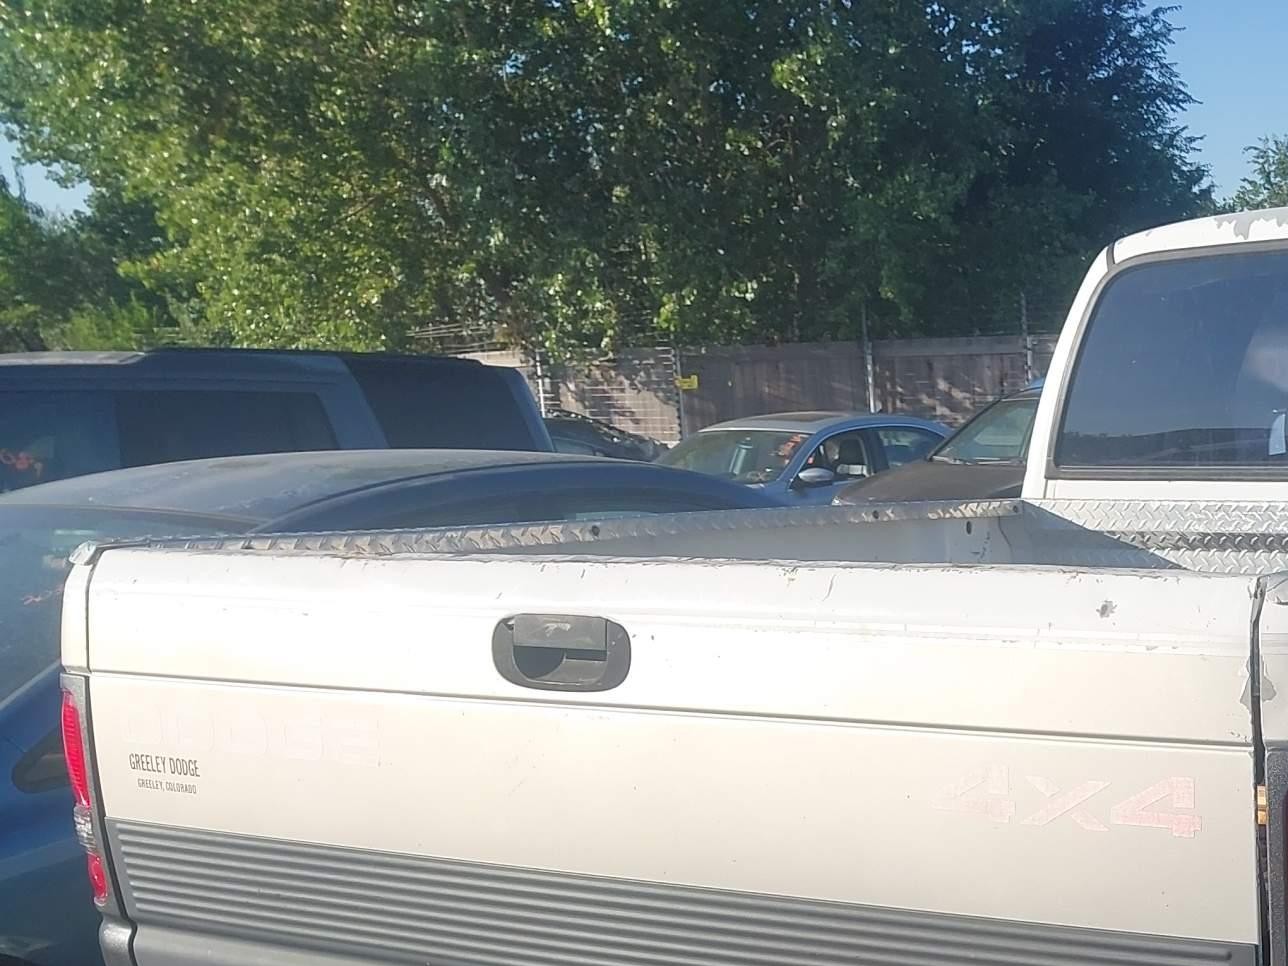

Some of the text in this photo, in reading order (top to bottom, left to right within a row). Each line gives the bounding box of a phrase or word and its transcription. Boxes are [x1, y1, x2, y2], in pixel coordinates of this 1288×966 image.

[129, 753, 200, 777] GREELEY DODGE
[137, 778, 197, 795] GREELEY, COLORADO
